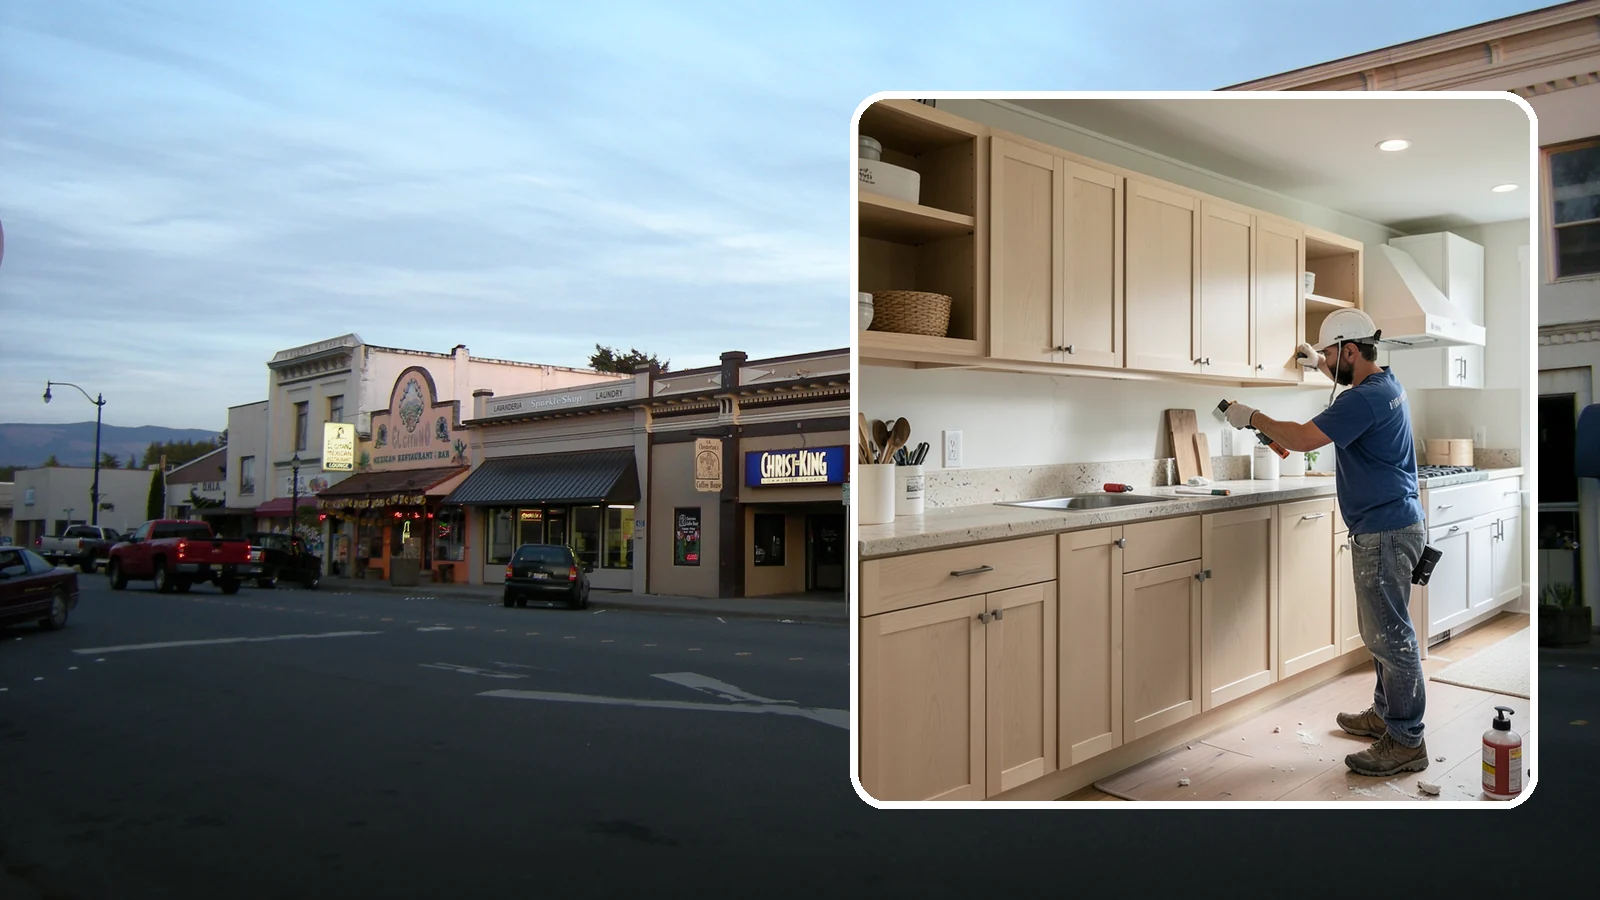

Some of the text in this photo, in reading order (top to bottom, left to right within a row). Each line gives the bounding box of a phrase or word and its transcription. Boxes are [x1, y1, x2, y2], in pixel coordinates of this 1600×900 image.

[531, 394, 582, 409] Sparkle Shop
[595, 389, 624, 400] LAUNDRY
[494, 402, 523, 413] LAVANDERIA
[392, 426, 402, 449] EL
[374, 455, 396, 464] MEXICAN
[397, 451, 433, 462] RESTAURANT
[438, 450, 450, 459] BAR
[760, 450, 828, 478] CHRIST KING
[696, 480, 722, 489] Coffee House
